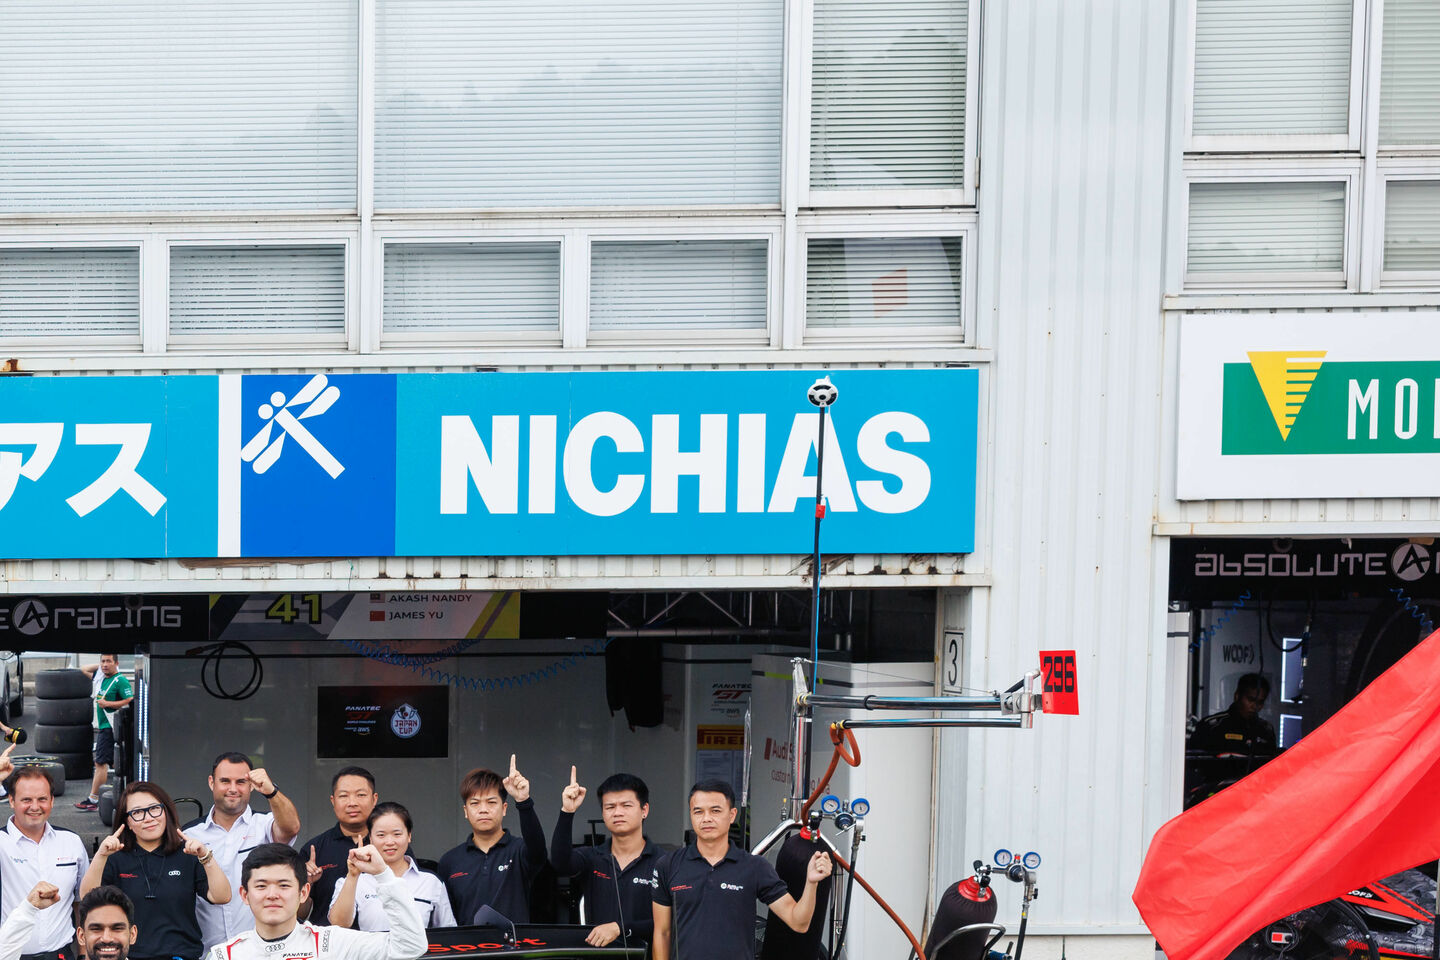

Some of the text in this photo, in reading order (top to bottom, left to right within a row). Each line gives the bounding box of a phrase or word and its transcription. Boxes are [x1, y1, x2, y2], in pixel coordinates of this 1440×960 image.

[440, 411, 931, 517] NICHIAS
[388, 593, 473, 603] AKASH NANDY
[264, 593, 322, 624] 41
[388, 611, 444, 620] JAMES YU
[948, 639, 959, 687] 3
[1043, 656, 1075, 693] 296
[394, 719, 418, 727] JAPAN
[399, 727, 413, 735] CUP
